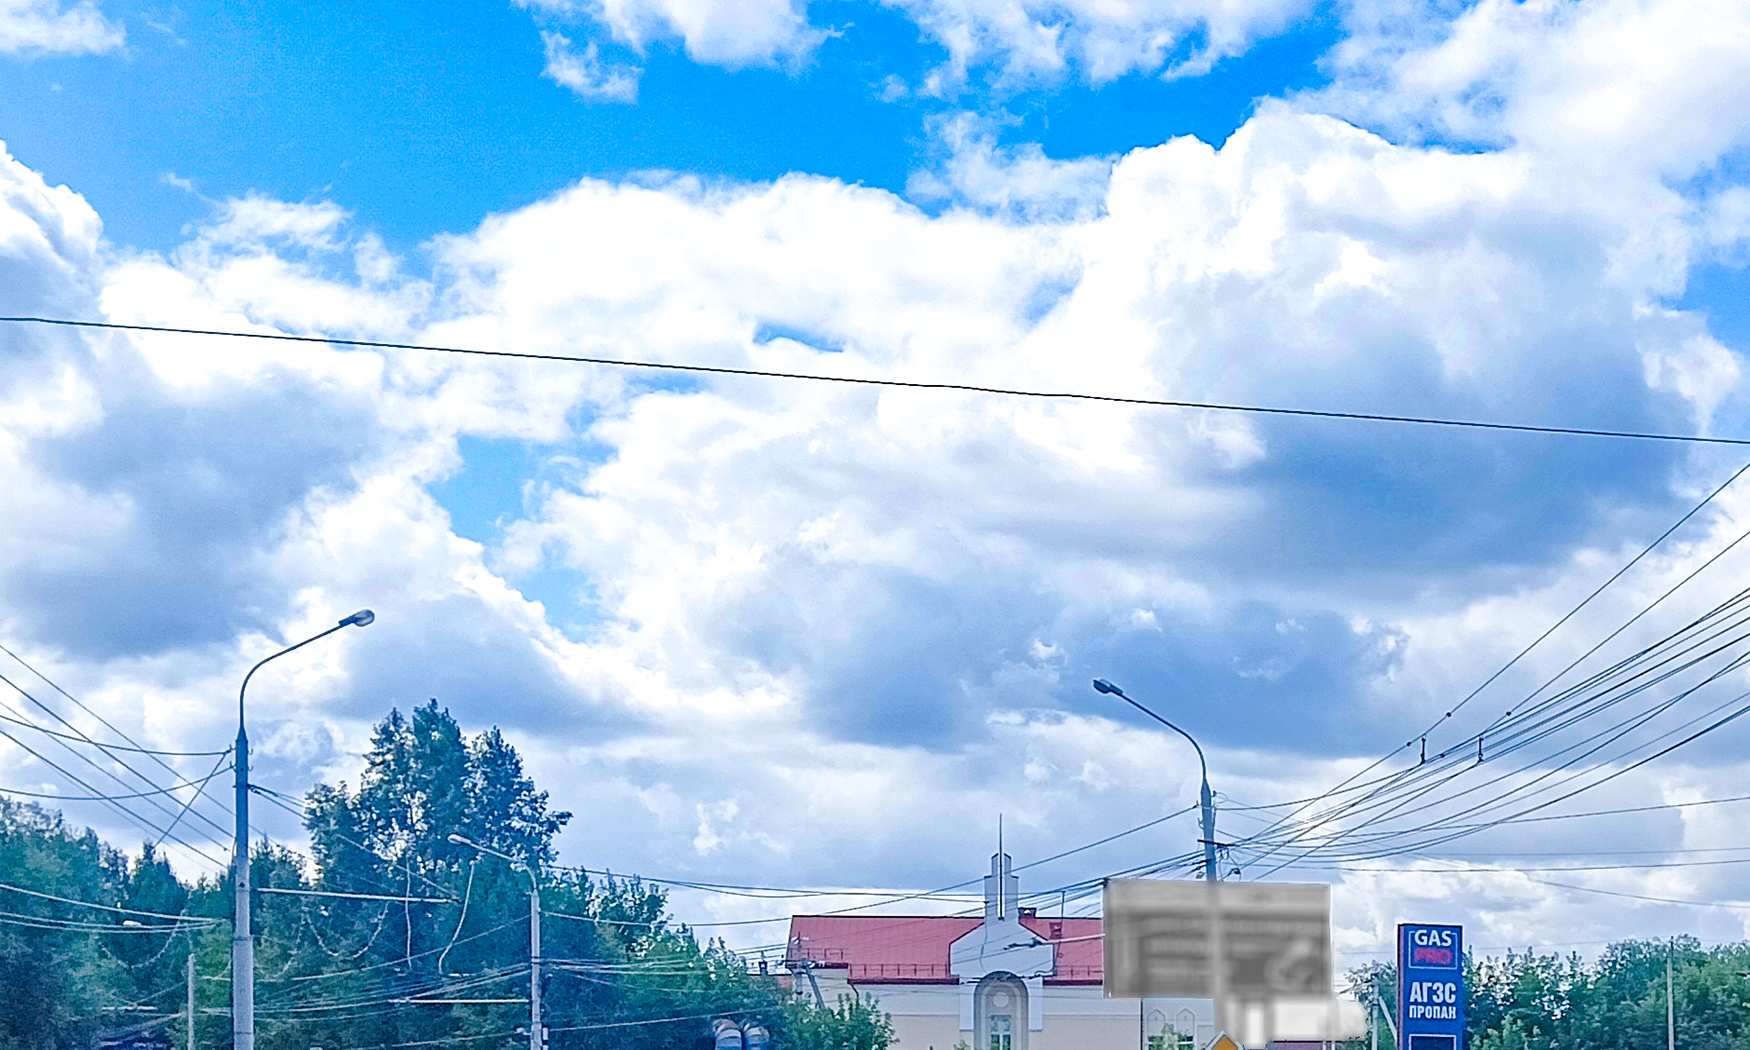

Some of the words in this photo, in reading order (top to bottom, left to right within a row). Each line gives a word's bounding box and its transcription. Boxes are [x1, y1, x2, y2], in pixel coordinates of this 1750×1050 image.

[1414, 929, 1452, 947] GAS
[1409, 981, 1457, 1003] АГЗС
[1408, 1005, 1457, 1019] ПРОПАН
